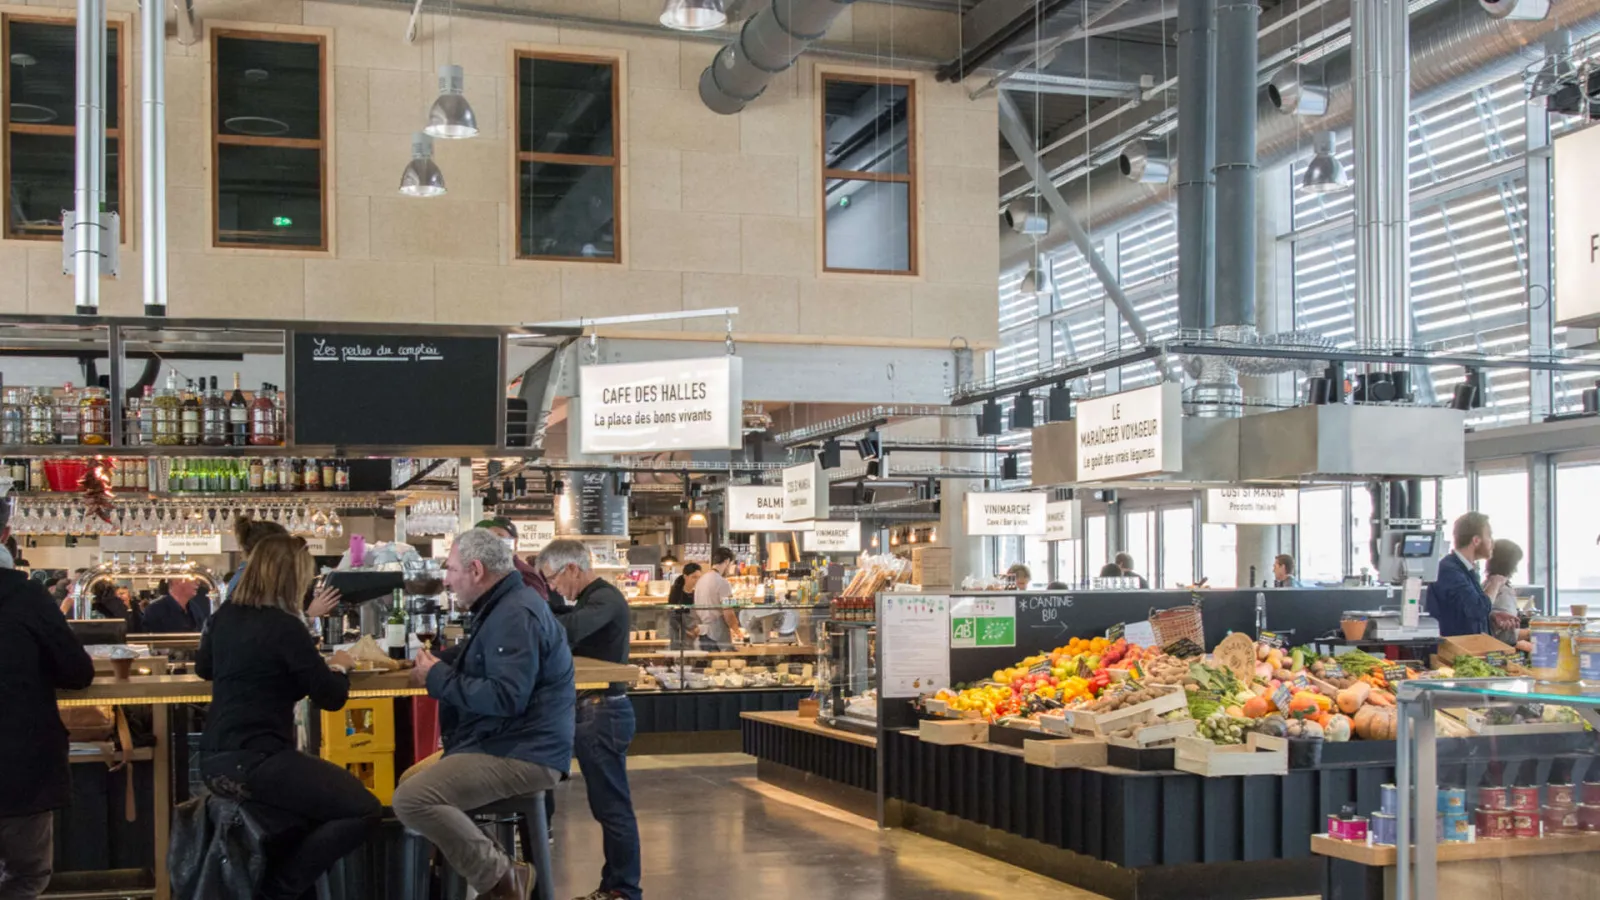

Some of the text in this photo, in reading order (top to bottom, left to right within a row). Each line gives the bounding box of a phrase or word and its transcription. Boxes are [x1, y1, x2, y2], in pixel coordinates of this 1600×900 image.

[313, 337, 337, 356] Les
[376, 345, 394, 356] du
[602, 382, 707, 405] CAFE DES HALLES
[594, 408, 712, 429] La place des bons vivants
[1112, 403, 1121, 421] LE
[1120, 418, 1158, 441] VOYAGEUR
[1103, 452, 1114, 466] des
[1115, 451, 1129, 463] vrais
[766, 512, 774, 520] de
[1029, 595, 1075, 610] CANTINE
[1042, 608, 1058, 622] BIO
[953, 622, 972, 639] AB
